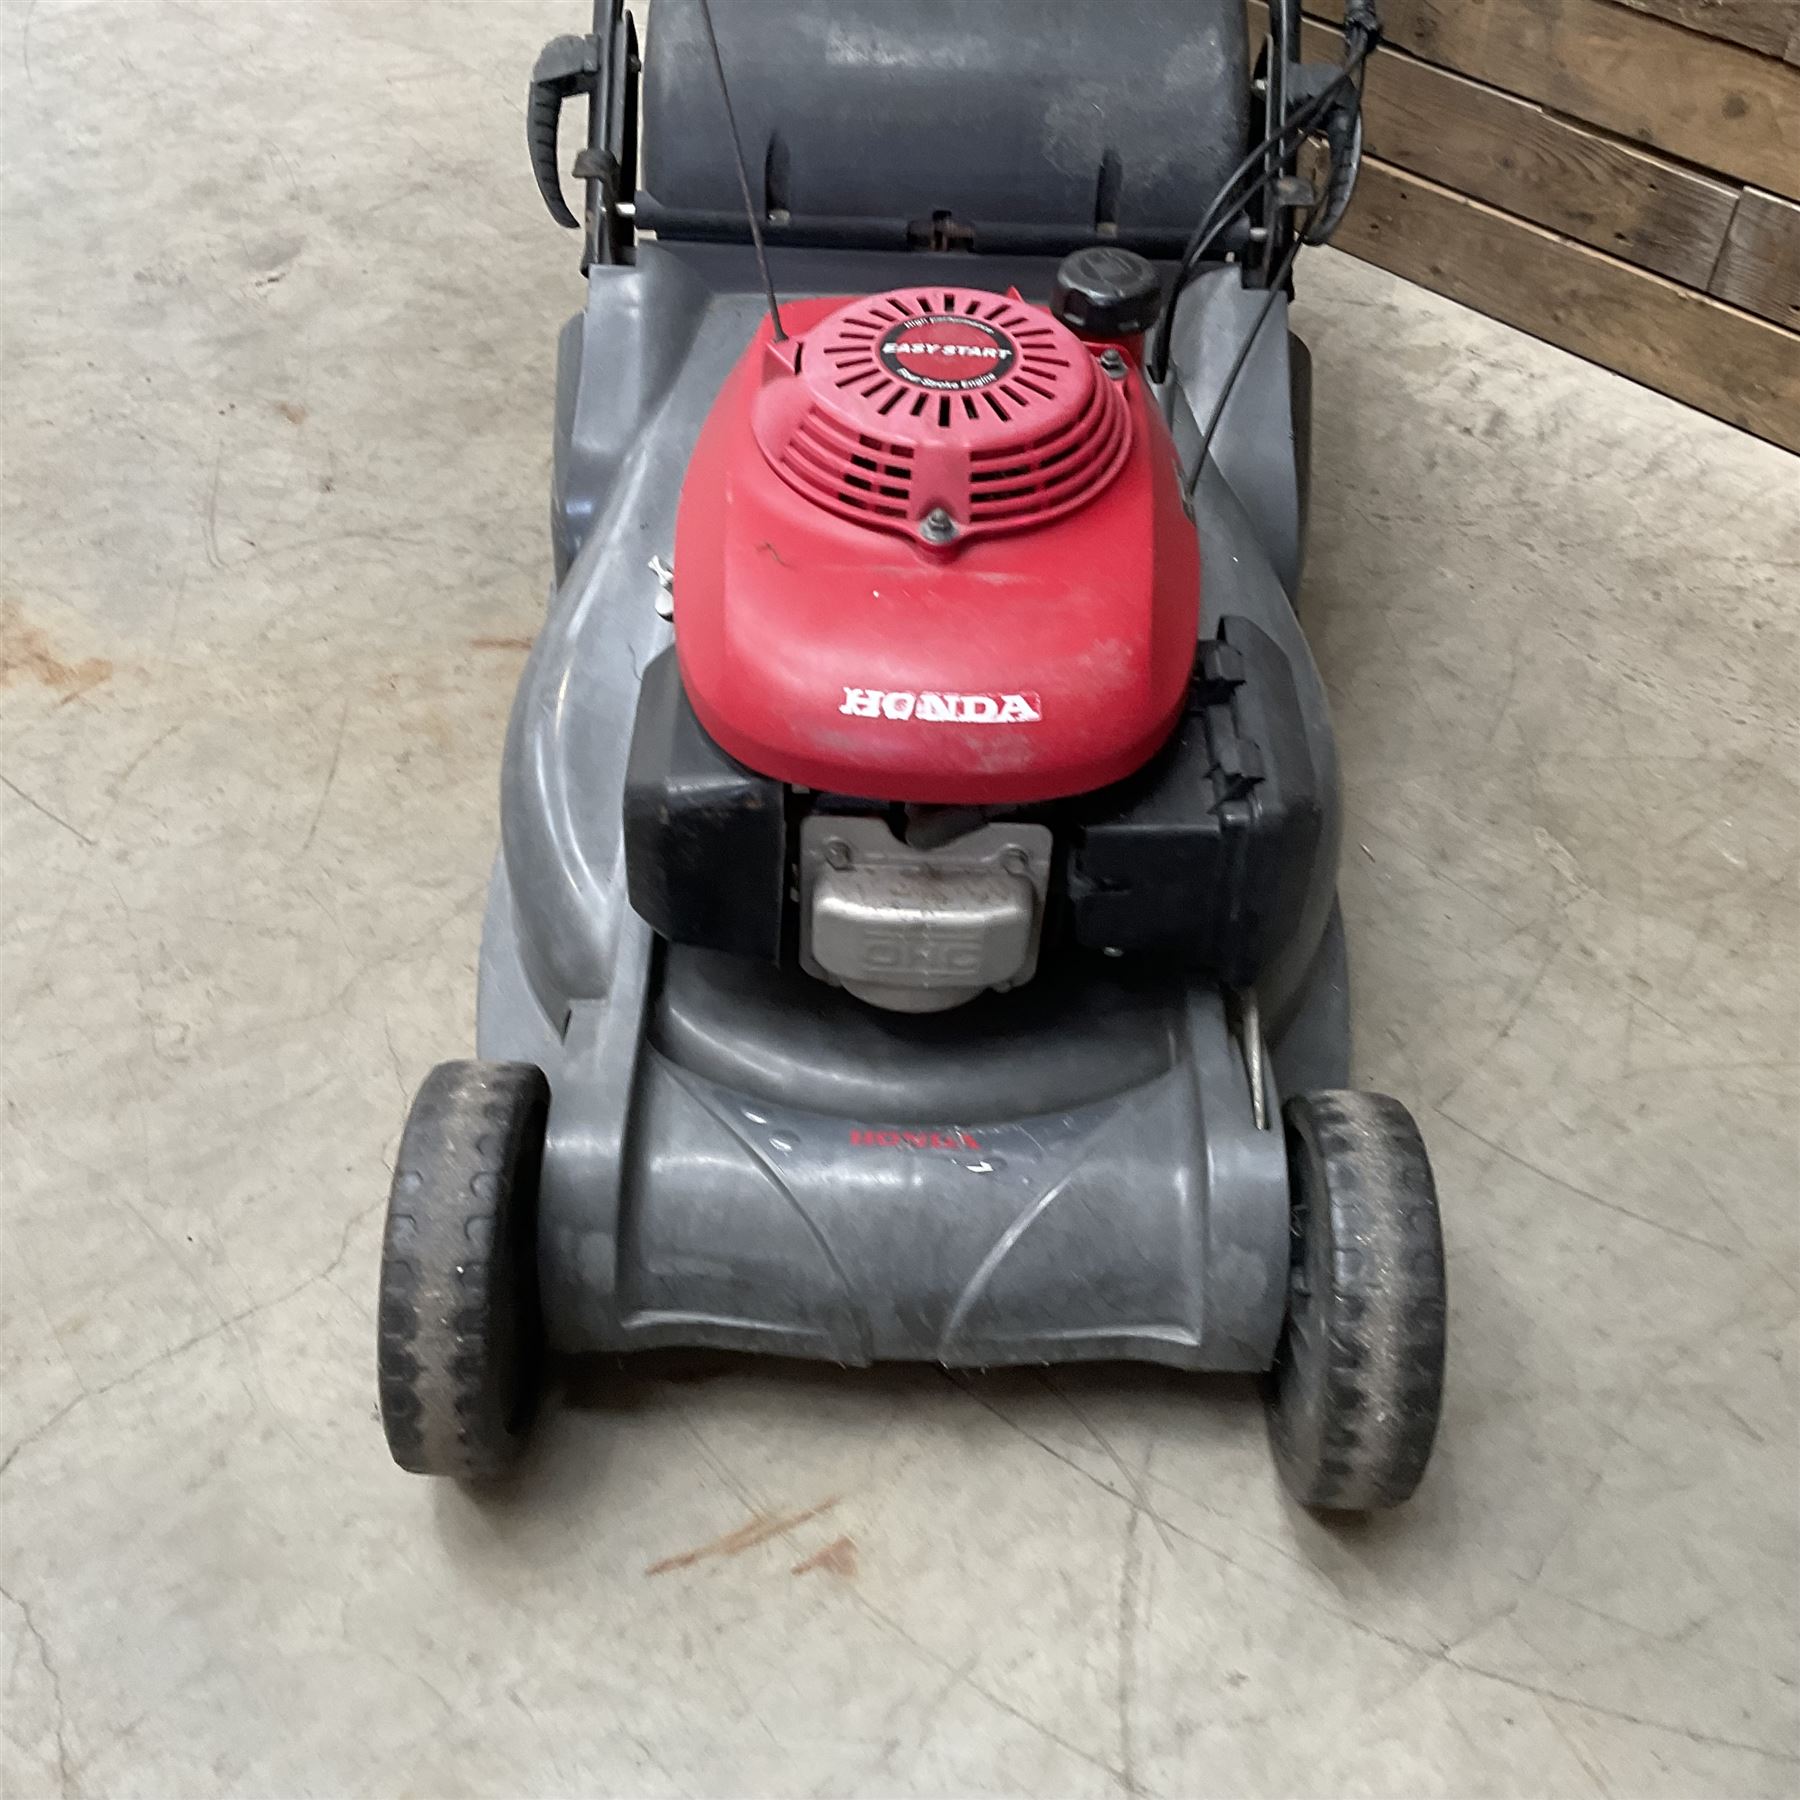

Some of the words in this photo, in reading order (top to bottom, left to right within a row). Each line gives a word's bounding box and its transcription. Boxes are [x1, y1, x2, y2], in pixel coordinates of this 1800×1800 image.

[882, 343, 941, 354] EASY
[941, 345, 1012, 359] START
[838, 686, 1042, 723] HONDA
